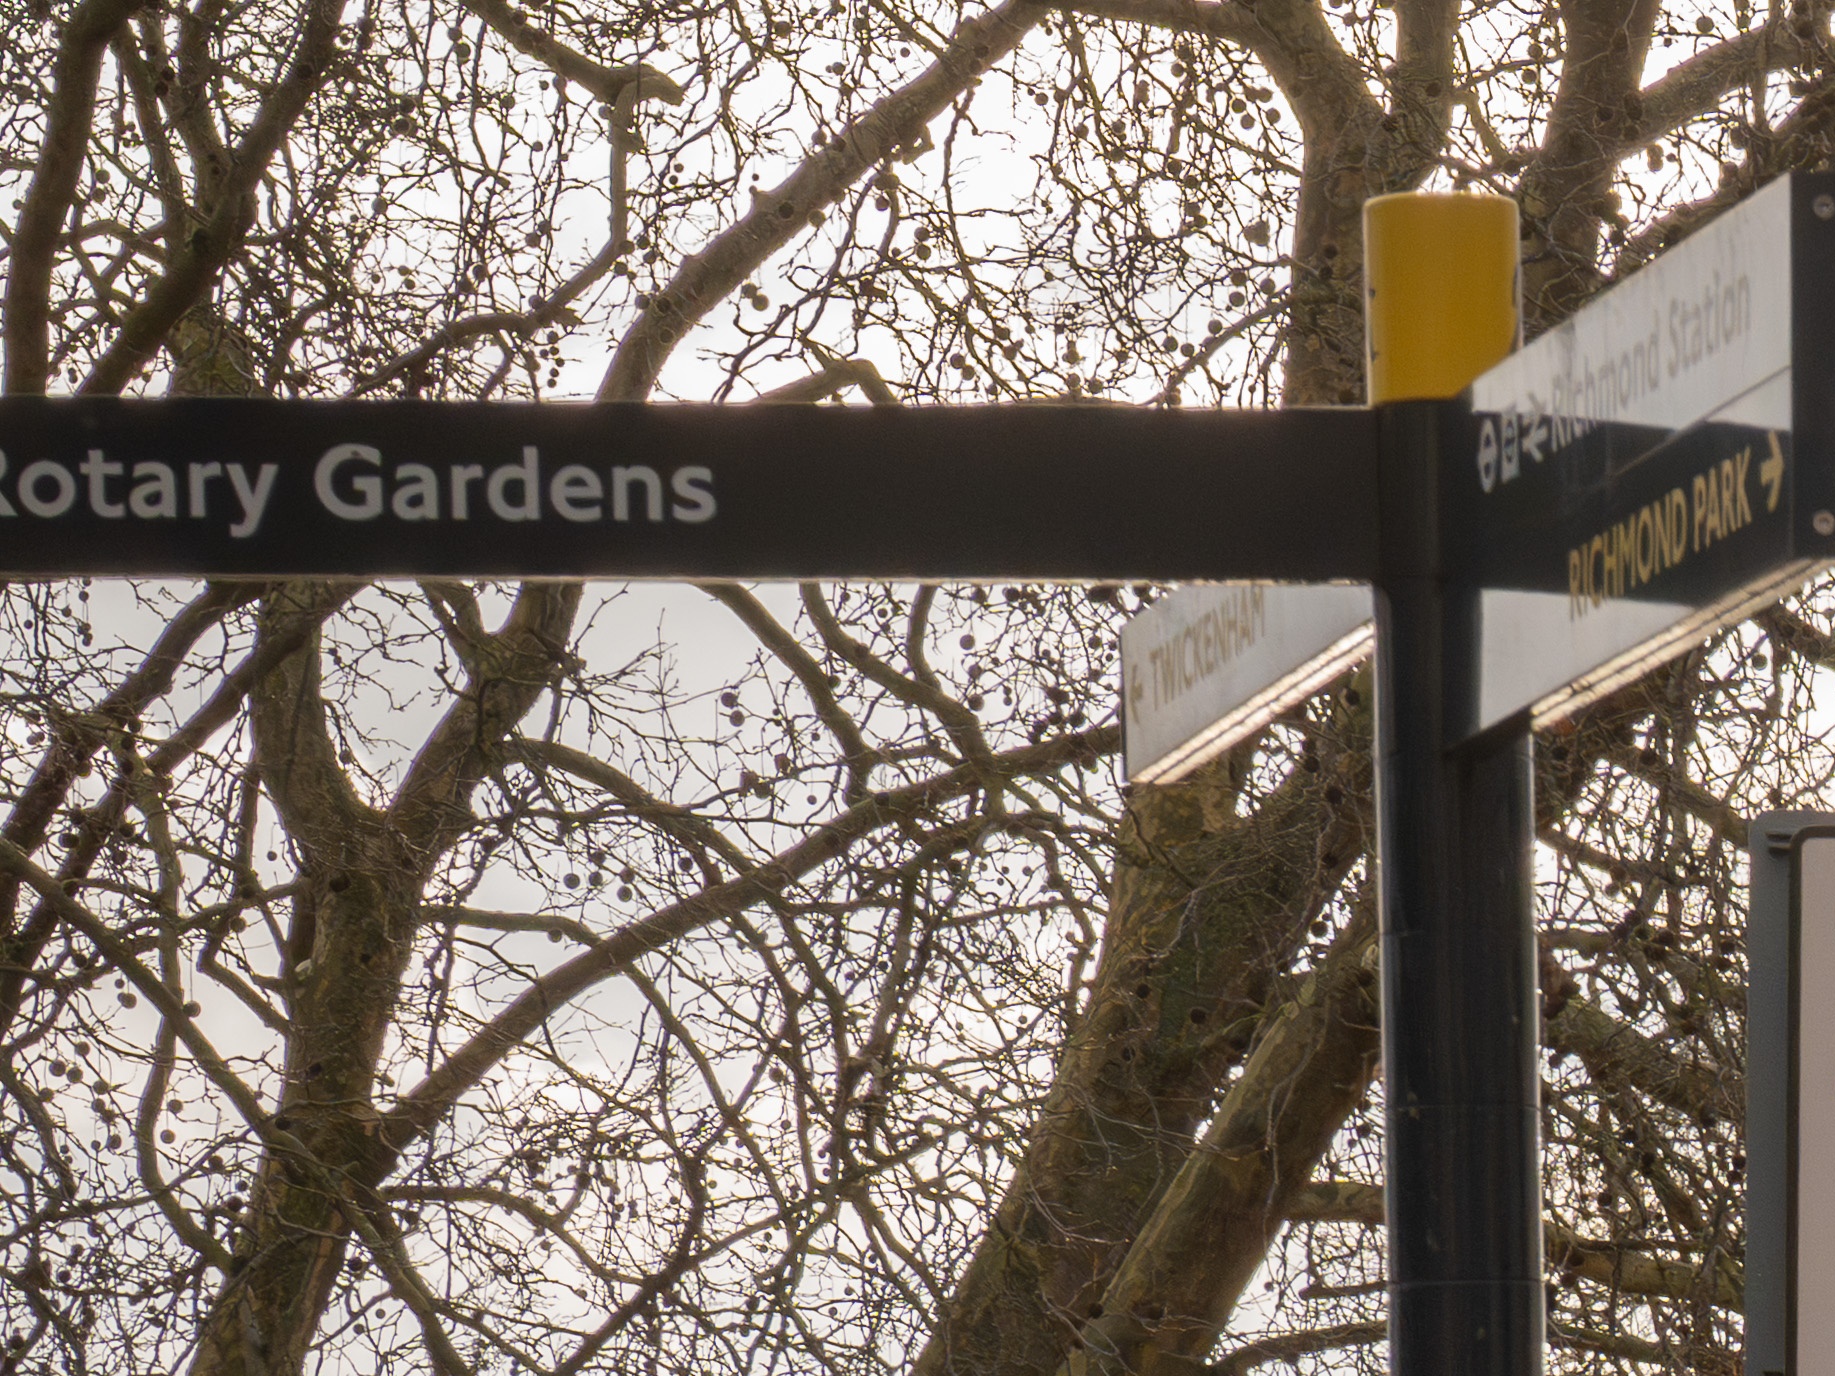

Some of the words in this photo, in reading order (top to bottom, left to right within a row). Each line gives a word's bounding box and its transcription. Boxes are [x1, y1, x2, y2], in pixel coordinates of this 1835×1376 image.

[1551, 323, 1661, 453] Richmond
[1668, 268, 1752, 380] Station
[314, 443, 718, 522] Gardens
[1567, 487, 1688, 622] RICHMOND
[1692, 446, 1752, 553] PARK
[1149, 586, 1265, 712] TWICKENHAM
